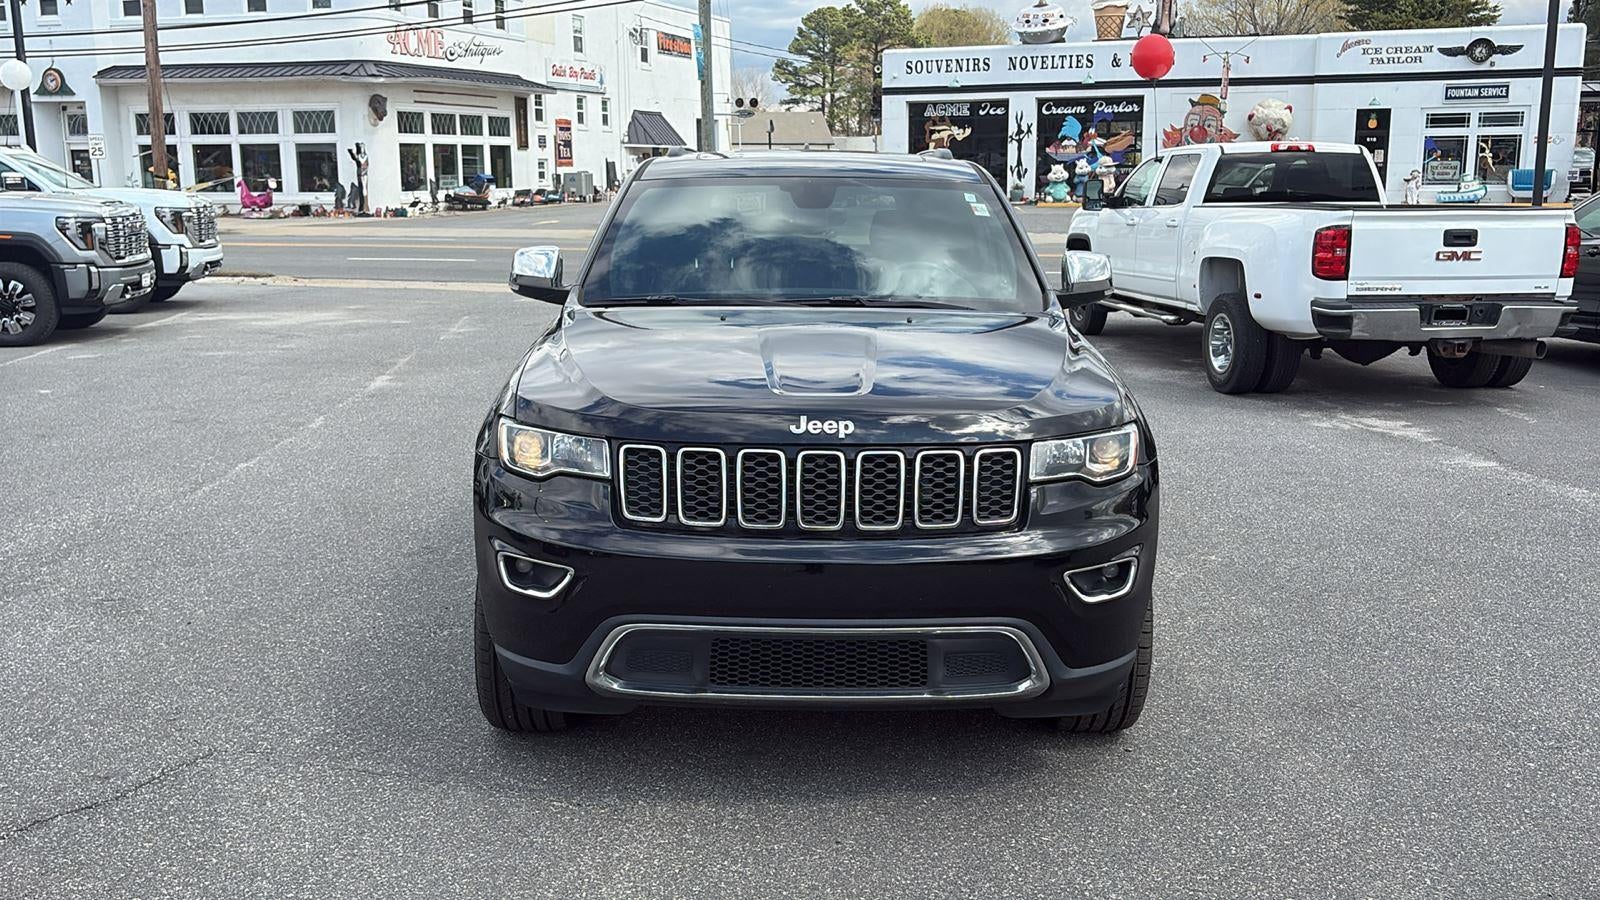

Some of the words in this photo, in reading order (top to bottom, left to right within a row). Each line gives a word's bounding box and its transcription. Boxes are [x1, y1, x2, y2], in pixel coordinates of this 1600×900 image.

[386, 26, 445, 60] ACME
[445, 36, 504, 65] Antiques
[657, 31, 691, 56] Firestone
[1361, 47, 1383, 56] ICE
[1386, 45, 1434, 55] CREAM
[905, 57, 991, 75] SOUVENIRS
[1007, 53, 1094, 71] NOVELTIES
[1111, 53, 1122, 68] &
[1369, 56, 1423, 65] PARLOR
[569, 66, 579, 81] Boy
[1447, 88, 1479, 98] FOUNTAIN
[1480, 87, 1508, 97] SERVICE
[924, 103, 971, 117] ACME
[979, 102, 1007, 116] Ice
[1041, 101, 1087, 115] Cream
[1093, 100, 1141, 114] Parlor
[91, 146, 104, 156] 25
[1435, 250, 1483, 262] GMC
[789, 415, 855, 439] Jeep
